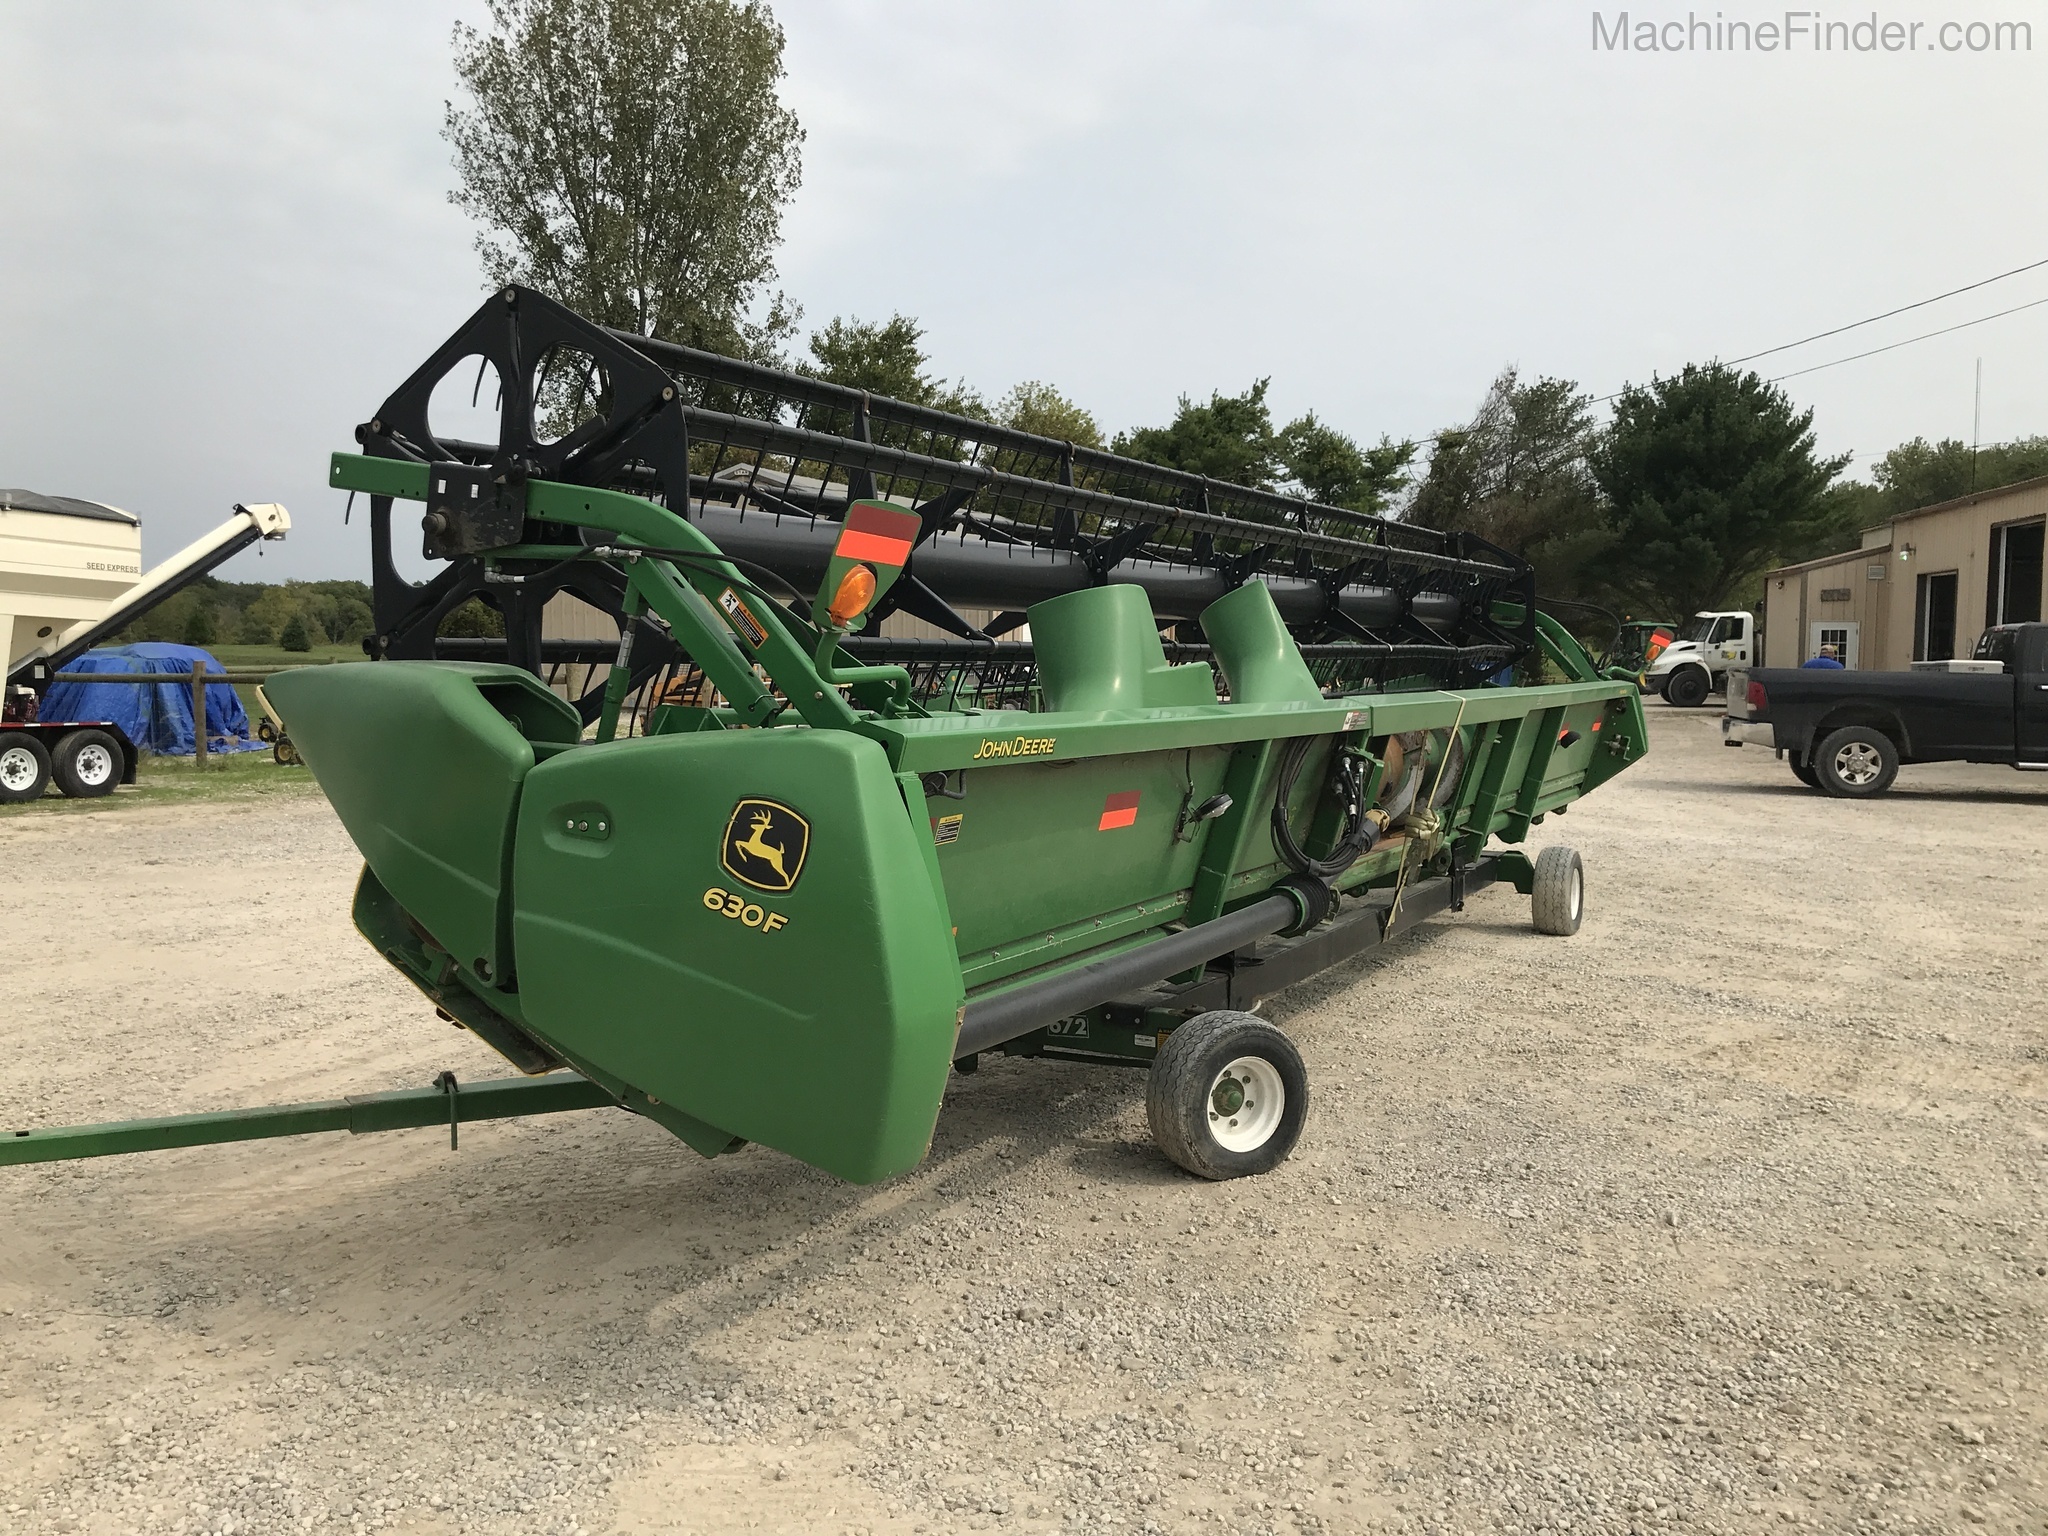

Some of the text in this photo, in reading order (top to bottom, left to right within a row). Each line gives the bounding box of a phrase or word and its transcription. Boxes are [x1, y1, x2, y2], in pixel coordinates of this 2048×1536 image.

[86, 562, 139, 573] SEED EXPRESS
[973, 736, 1056, 760] JOHN DEERE
[702, 887, 790, 934] 630F
[1049, 1017, 1087, 1035] 672
